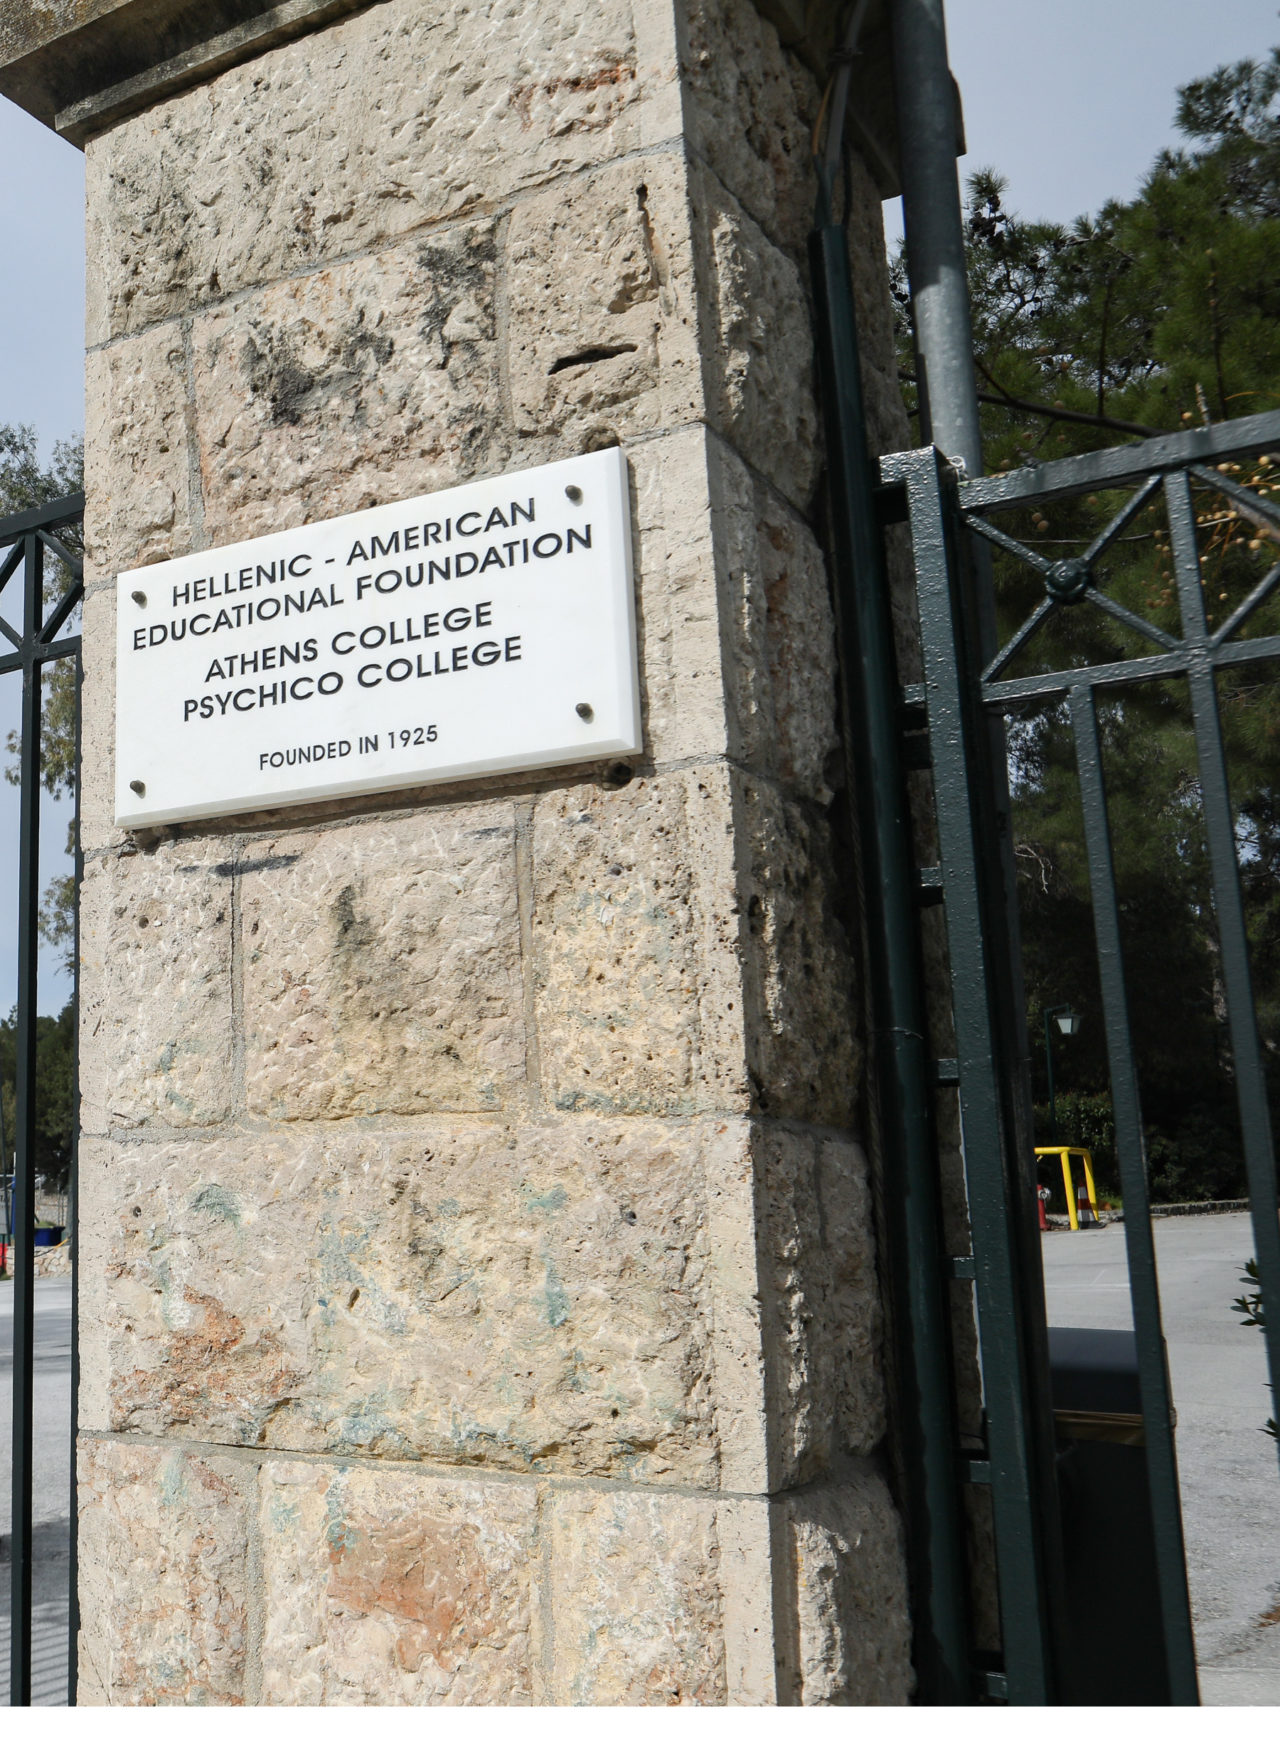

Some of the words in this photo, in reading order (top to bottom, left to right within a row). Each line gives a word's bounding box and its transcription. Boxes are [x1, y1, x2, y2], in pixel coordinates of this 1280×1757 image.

[132, 583, 345, 651] EDUCATIONAL
[356, 523, 593, 601] FOUNDATION
[172, 554, 312, 607] HELLENIC
[346, 497, 536, 567] AMERICAN
[183, 671, 344, 722] PSYCHICO
[357, 635, 523, 689] COLLEGE
[204, 638, 319, 683] ATHENS
[331, 601, 493, 656] COLLEGE
[259, 740, 353, 771] FOUNDED
[358, 735, 379, 755] IN
[387, 725, 439, 749] 1925
